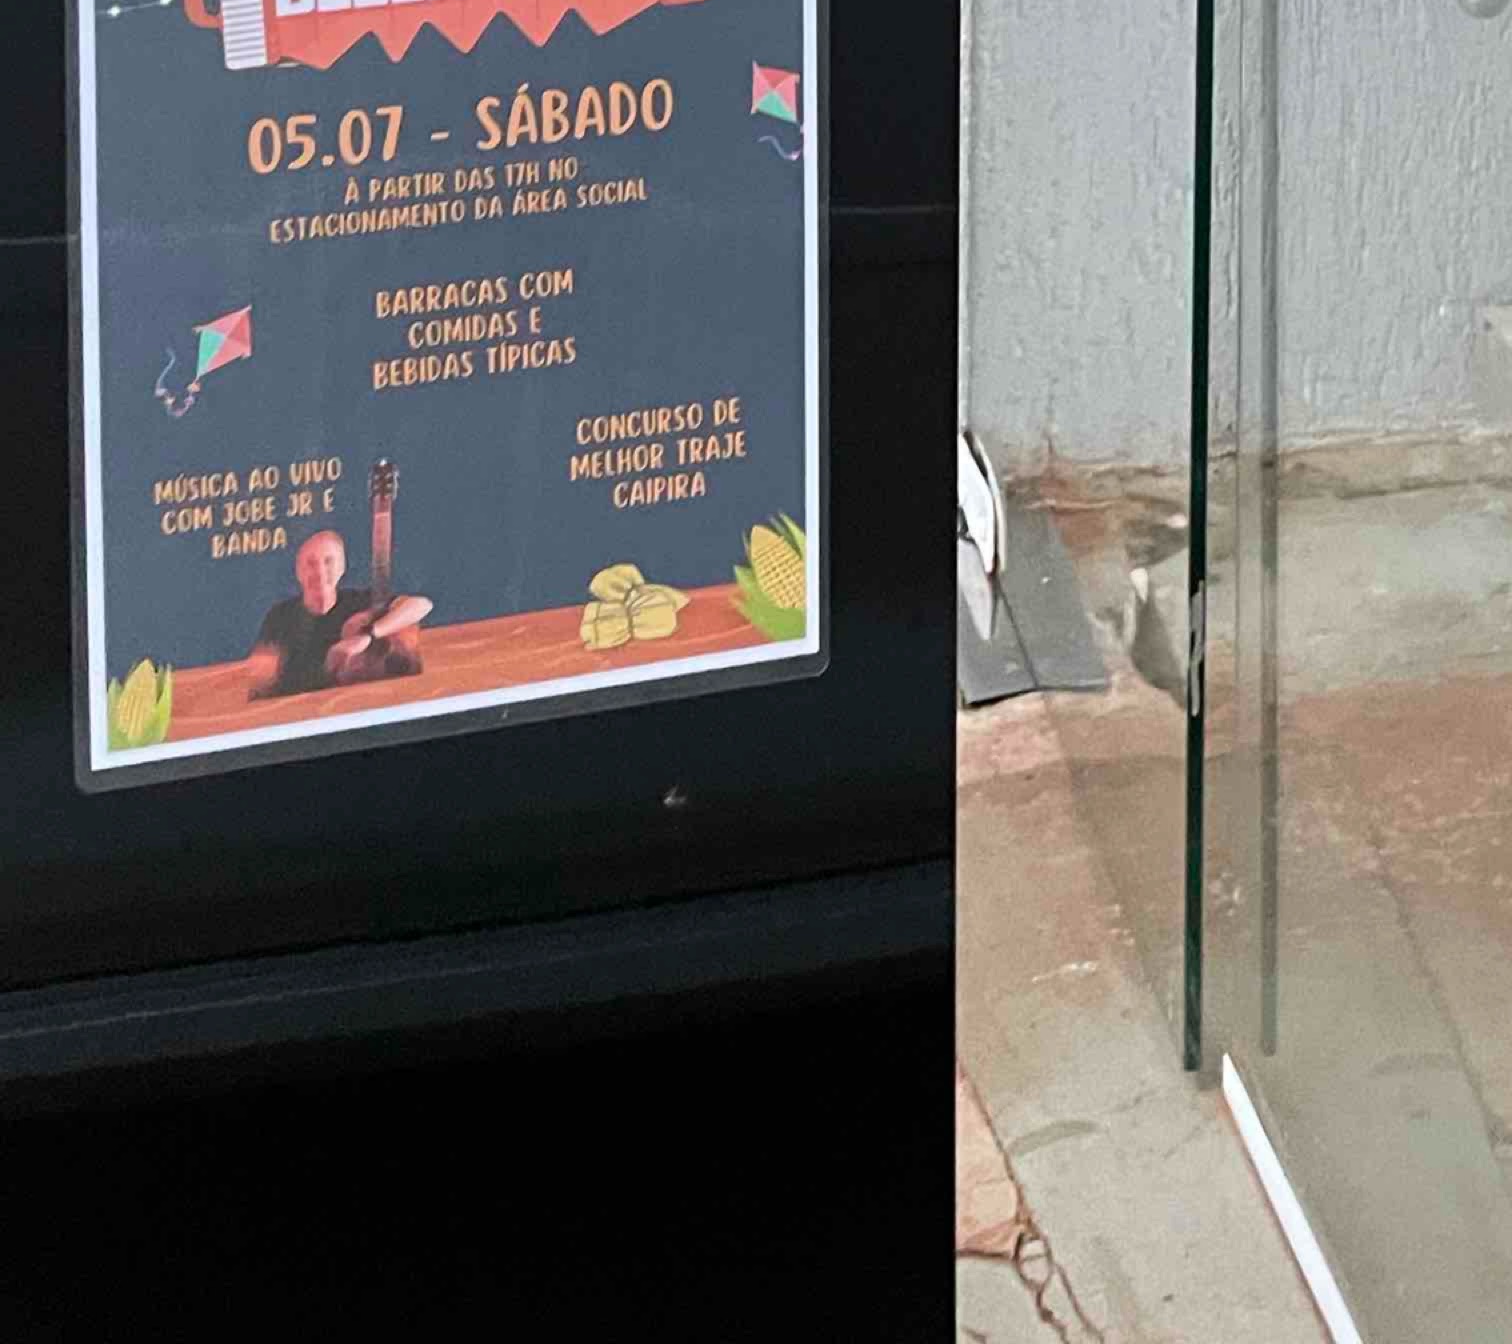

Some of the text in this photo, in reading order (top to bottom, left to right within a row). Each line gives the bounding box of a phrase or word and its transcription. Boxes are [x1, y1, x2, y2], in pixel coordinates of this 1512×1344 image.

[247, 77, 674, 175] 05.07 - SÁBADO
[369, 172, 445, 202] PARTIR
[455, 165, 496, 192] DAS
[505, 161, 541, 188] 17H
[548, 155, 579, 182] NO
[270, 176, 649, 244] ESTACIONAMENTO DA ÁREA SOCIAL
[375, 268, 574, 319] BARRACAS COM
[407, 305, 542, 350] COMIDAS E
[372, 335, 577, 392] BEBIDAS TÍPICAS
[576, 395, 741, 446] CONCURSO DE
[570, 429, 747, 482] MELHOR TRAJE
[153, 456, 343, 506] MÚSICA AO VIVO
[613, 470, 706, 509] CAIPIRA
[160, 486, 337, 536] COM JOBE JR E
[211, 526, 289, 560] BANDA
